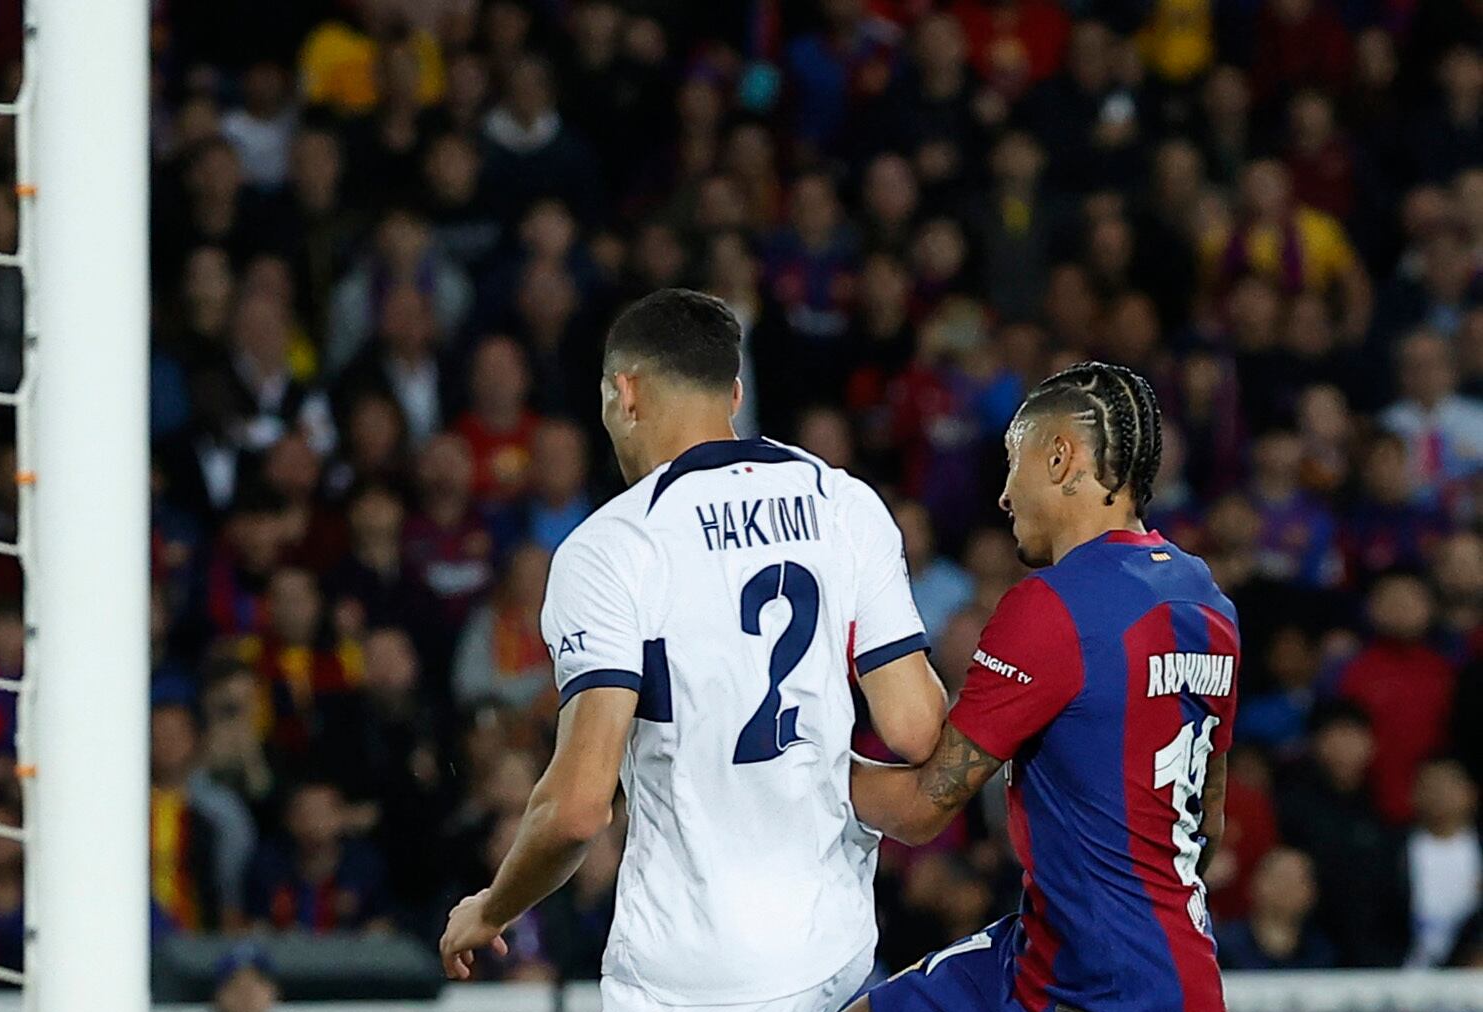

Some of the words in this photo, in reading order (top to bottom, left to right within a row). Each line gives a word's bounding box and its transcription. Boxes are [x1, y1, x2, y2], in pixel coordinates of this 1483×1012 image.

[695, 494, 821, 551] HAKIMI
[732, 560, 820, 765] 2
[1017, 671, 1033, 685] tv
